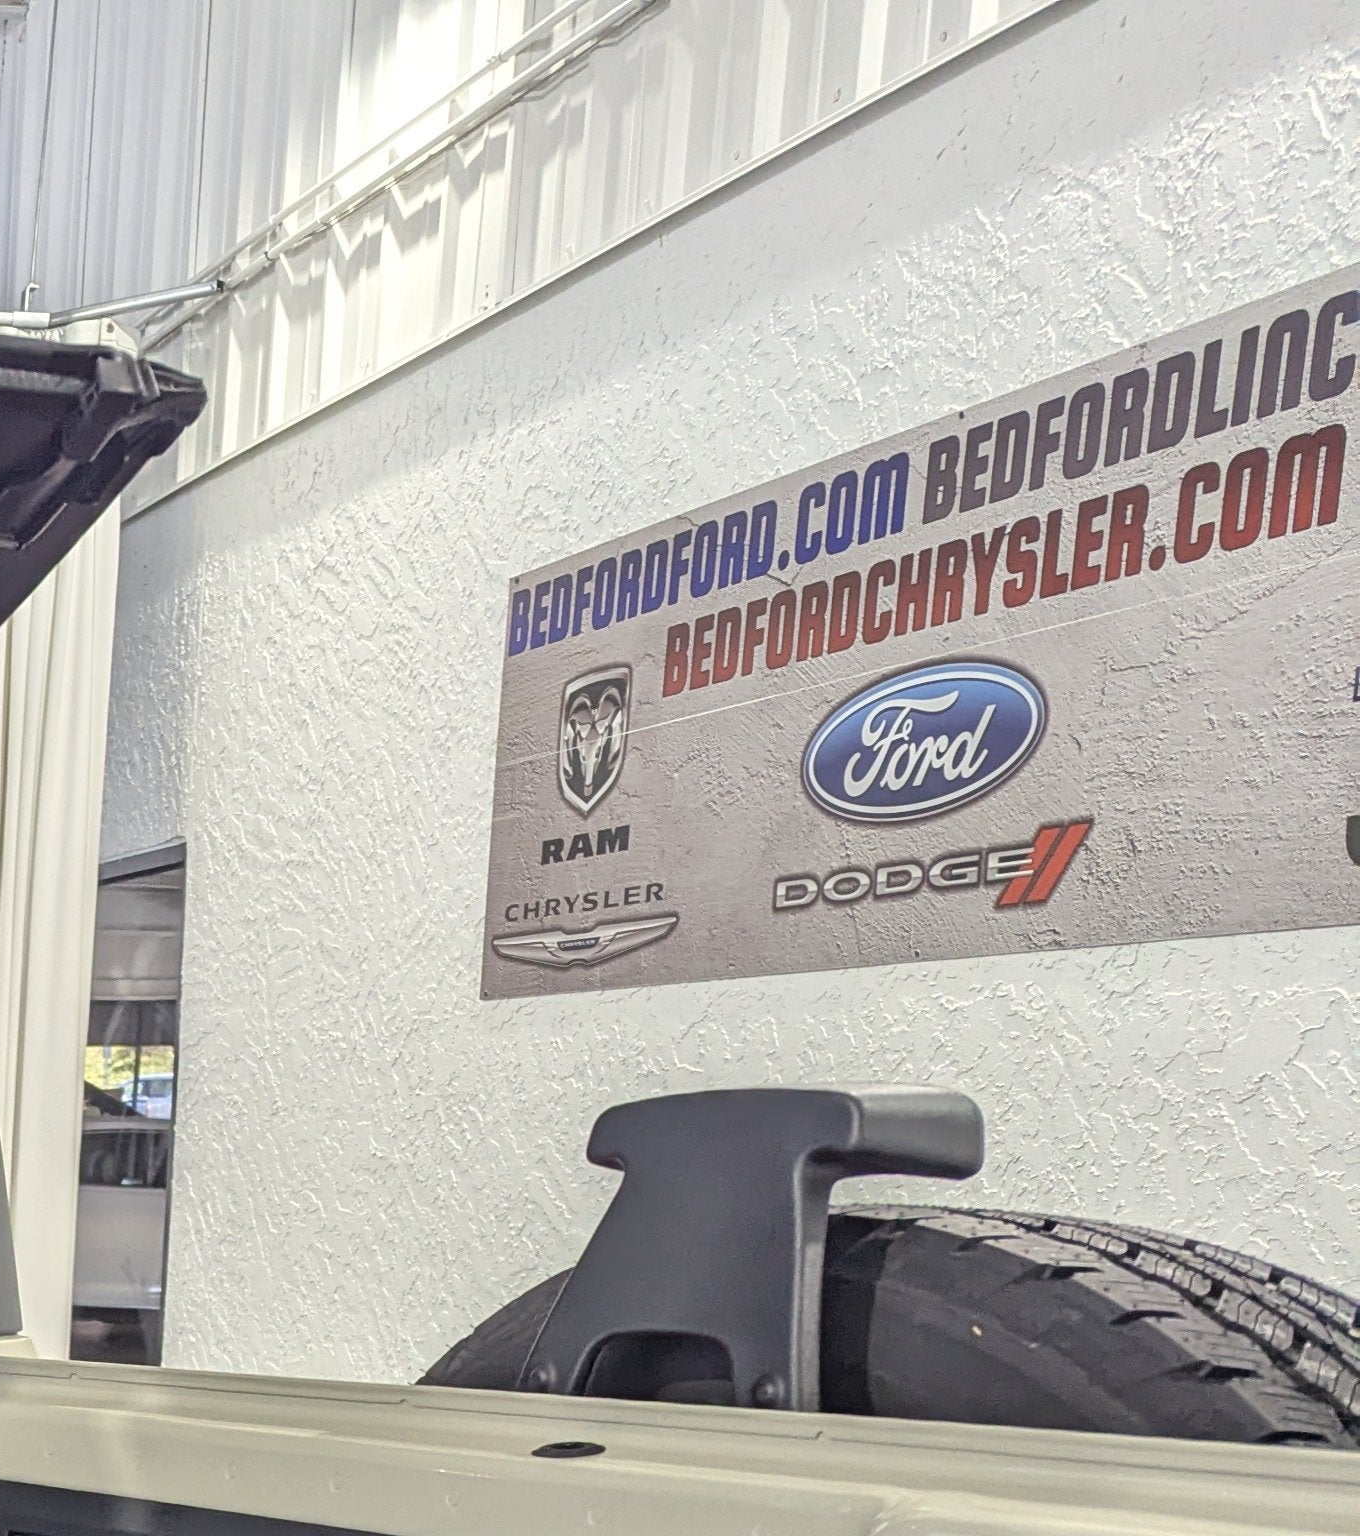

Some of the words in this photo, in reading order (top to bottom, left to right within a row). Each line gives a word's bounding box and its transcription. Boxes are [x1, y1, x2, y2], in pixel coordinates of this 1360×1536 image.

[508, 451, 910, 656] BEDFORDFORD.COM
[662, 424, 1347, 698] BEDFORDCHRYSLER.COM
[843, 690, 996, 797] Ford
[541, 825, 630, 865] RAM
[775, 847, 1035, 908] DODGE
[504, 883, 664, 922] CHRYSLER
